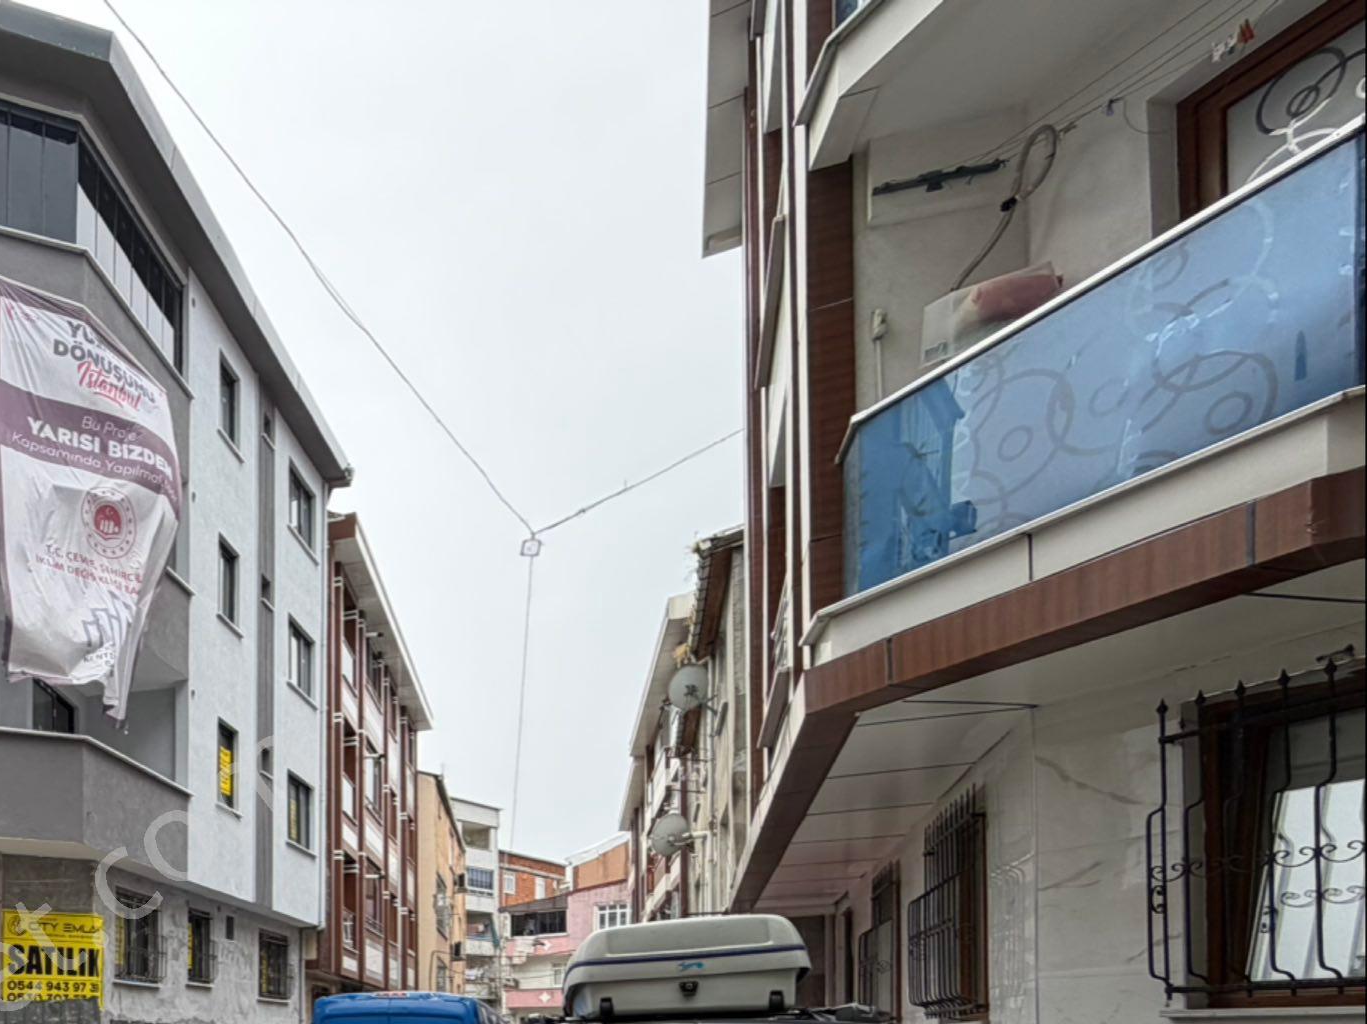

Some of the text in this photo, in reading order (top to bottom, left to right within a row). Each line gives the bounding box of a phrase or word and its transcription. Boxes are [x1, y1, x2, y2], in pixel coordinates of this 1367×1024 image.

[27, 416, 100, 453] YARISI
[63, 923, 100, 933] EMLA
[8, 944, 99, 977] SATILIK
[7, 981, 42, 991] 0544
[46, 982, 70, 992] 943
[73, 983, 87, 992] 97
